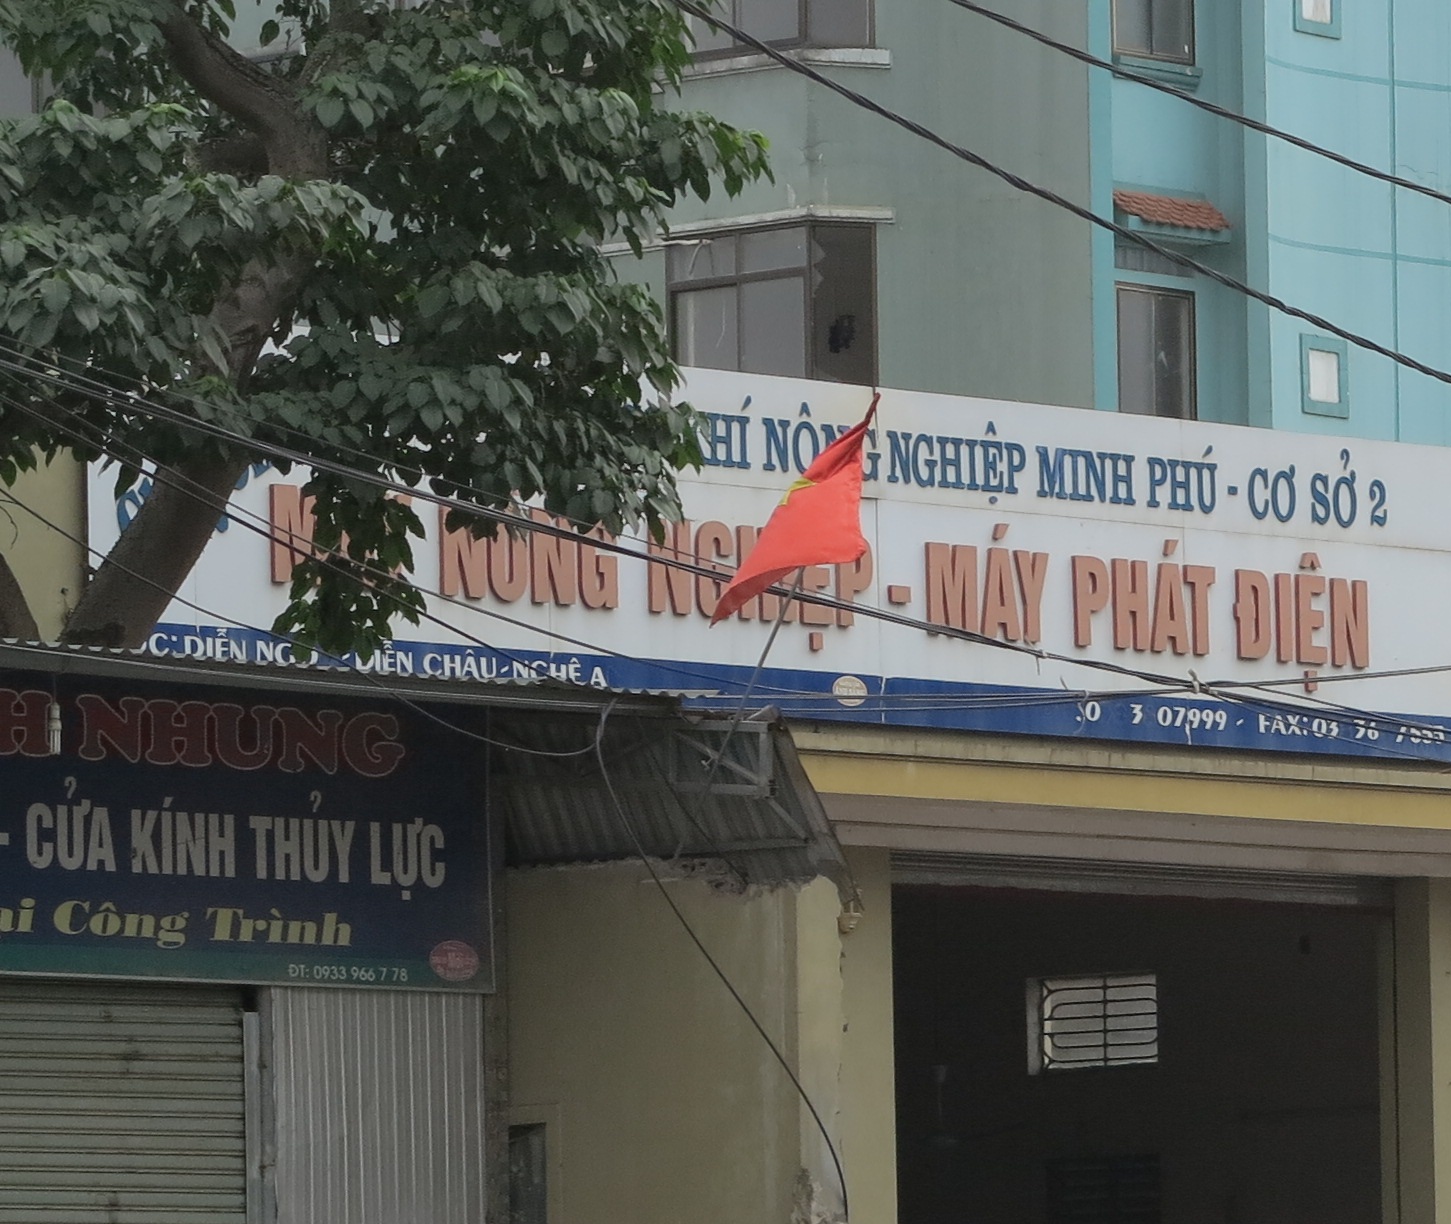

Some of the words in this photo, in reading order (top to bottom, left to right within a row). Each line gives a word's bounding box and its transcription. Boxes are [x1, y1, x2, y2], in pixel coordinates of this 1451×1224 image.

[762, 401, 881, 481] NÔG
[887, 420, 1027, 505] NGHIỆP
[1036, 445, 1136, 506] MINH
[1146, 445, 1218, 515] PHÚ
[1248, 464, 1297, 523] CƠ
[1310, 448, 1358, 528] SỞ
[1369, 478, 1389, 527] 2
[648, 519, 873, 652] NGỆP
[925, 524, 1048, 643] MÁY
[1071, 539, 1216, 657] PHÁT
[1233, 552, 1370, 693] ĐIỆN
[76, 693, 405, 777] NHUNG
[26, 776, 117, 873] CỬA
[131, 796, 236, 879] KÍNH
[248, 790, 357, 884] THỦY
[369, 817, 447, 902] LỰC
[53, 899, 190, 949] Công
[206, 907, 352, 948] Trình
[313, 965, 347, 981] 0933
[350, 966, 376, 982] 966
